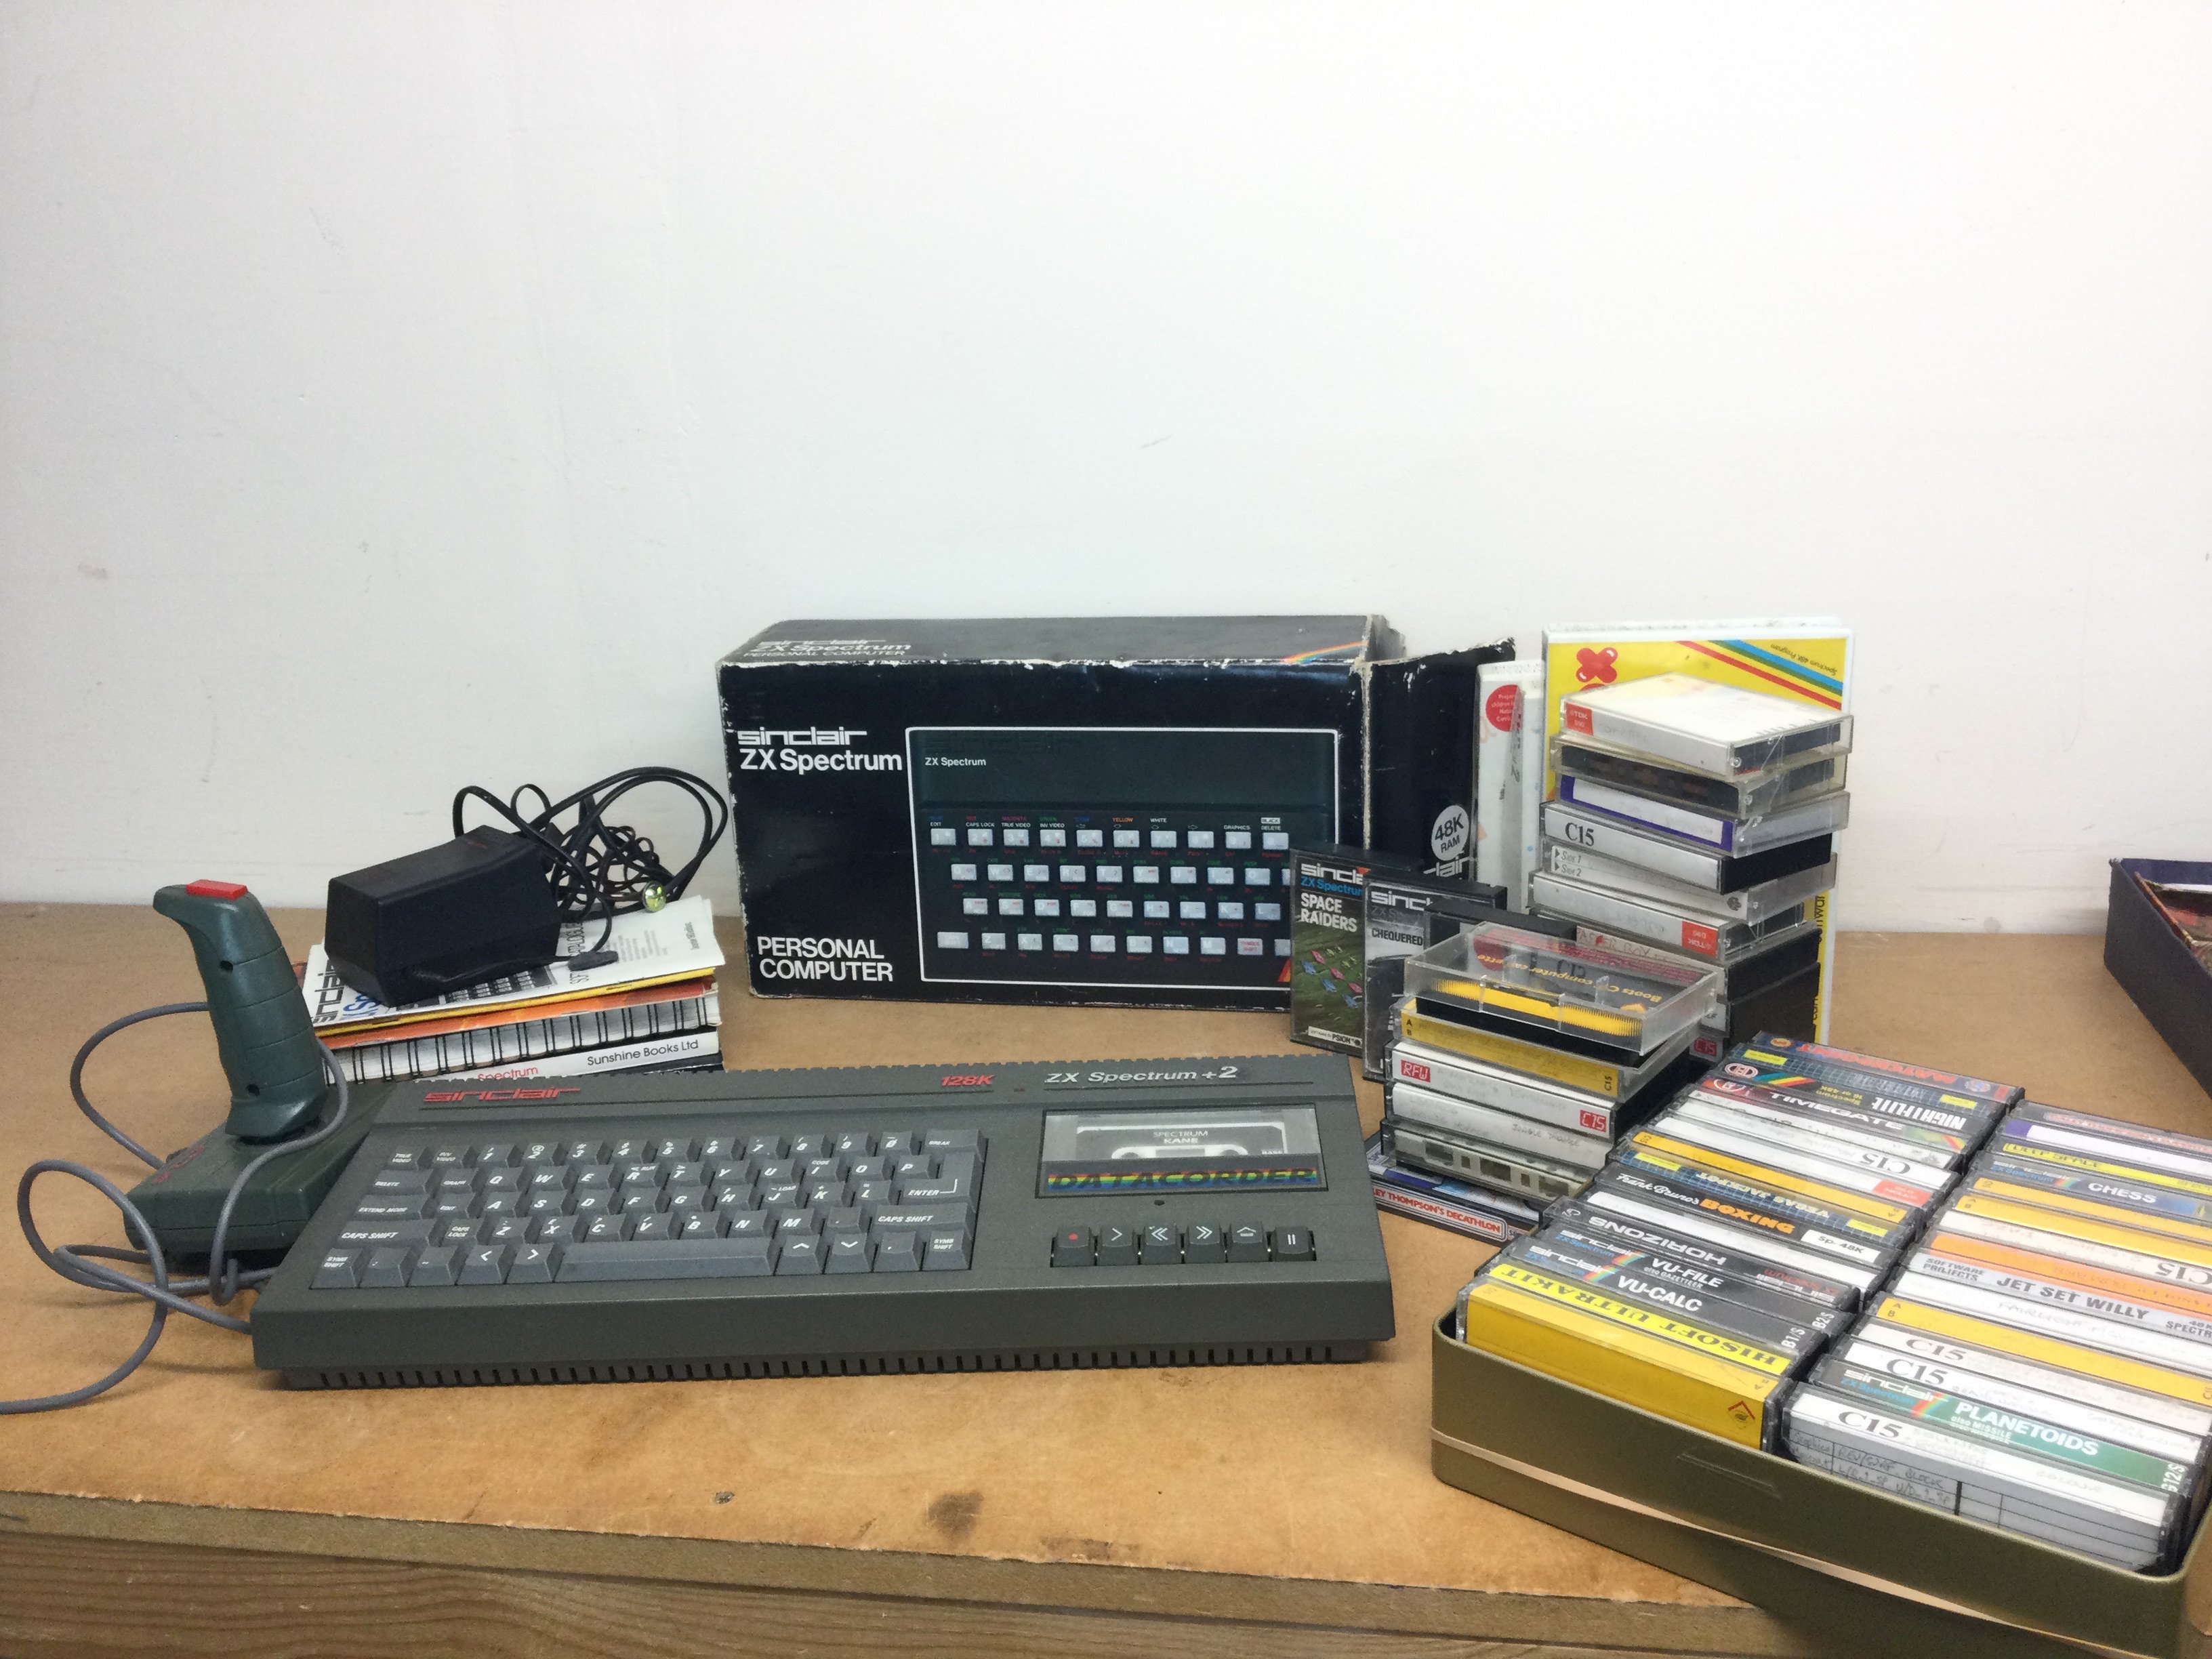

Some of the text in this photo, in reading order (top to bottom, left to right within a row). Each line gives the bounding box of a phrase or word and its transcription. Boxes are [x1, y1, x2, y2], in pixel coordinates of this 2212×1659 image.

[737, 726, 867, 745] sinclair
[739, 748, 903, 775] ZX Spectrum
[924, 757, 987, 768] ZX Spectrum
[1435, 813, 1465, 841] 48K
[1565, 821, 1595, 847] C15
[1440, 834, 1460, 853] RAM
[1300, 875, 1315, 888] ZX
[1576, 868, 1582, 878] 2
[1300, 892, 1343, 914] SPACE
[1300, 907, 1358, 933] RAIDERS
[757, 936, 885, 960] PERSONAL
[1371, 927, 1424, 947] CHEQUERED
[760, 958, 894, 982] COMPUTER
[1531, 966, 1594, 985] computer
[1622, 987, 1662, 1003] Boots
[587, 1040, 699, 1066] Sunshine Books Ltd
[941, 1074, 993, 1086] 128K
[1044, 1072, 1080, 1083] ZX
[1088, 1070, 1197, 1083] Spectrum
[1404, 1063, 1429, 1081] RFU
[424, 1086, 582, 1103] sinclair
[1604, 1075, 1612, 1092] C15
[1581, 1111, 1606, 1131] C15
[1769, 1091, 1905, 1130] TIMEGATE
[1153, 1130, 1208, 1138] SPECTRUM
[1859, 1152, 1911, 1176] C15
[1052, 1168, 1317, 1190] DATACORDER
[1616, 1172, 1653, 1191] Frank
[1699, 1198, 1795, 1234] BOXING
[2088, 1183, 2156, 1204] CHESS
[905, 1215, 934, 1223] SHIFT
[1387, 1191, 1445, 1216] THOMPSON'S
[1446, 1210, 1500, 1233] DECATHLON
[1589, 1216, 1727, 1267] HORIZONS
[1841, 1242, 1865, 1254] 48K
[1529, 1246, 1616, 1274] sinclair
[1926, 1258, 1985, 1275] SOFTWARE
[1652, 1257, 1724, 1288] VU-FILE
[1923, 1263, 1978, 1282] PROJECTS
[1616, 1275, 1702, 1312] VU-CALC
[1997, 1277, 2036, 1294] JET
[2040, 1287, 2081, 1304] SET
[2087, 1297, 2150, 1319] WILLY
[1501, 1268, 1776, 1365] HISOFT ULTRAKIT
[1780, 1327, 1806, 1349] B1/S
[1906, 1338, 1967, 1361] C15
[1886, 1359, 1948, 1385] C15
[1843, 1369, 1948, 1403] sinclair
[1838, 1411, 1902, 1439] C15
[1951, 1415, 1973, 1426] also
[1954, 1401, 2100, 1456] PLANETOIDS
